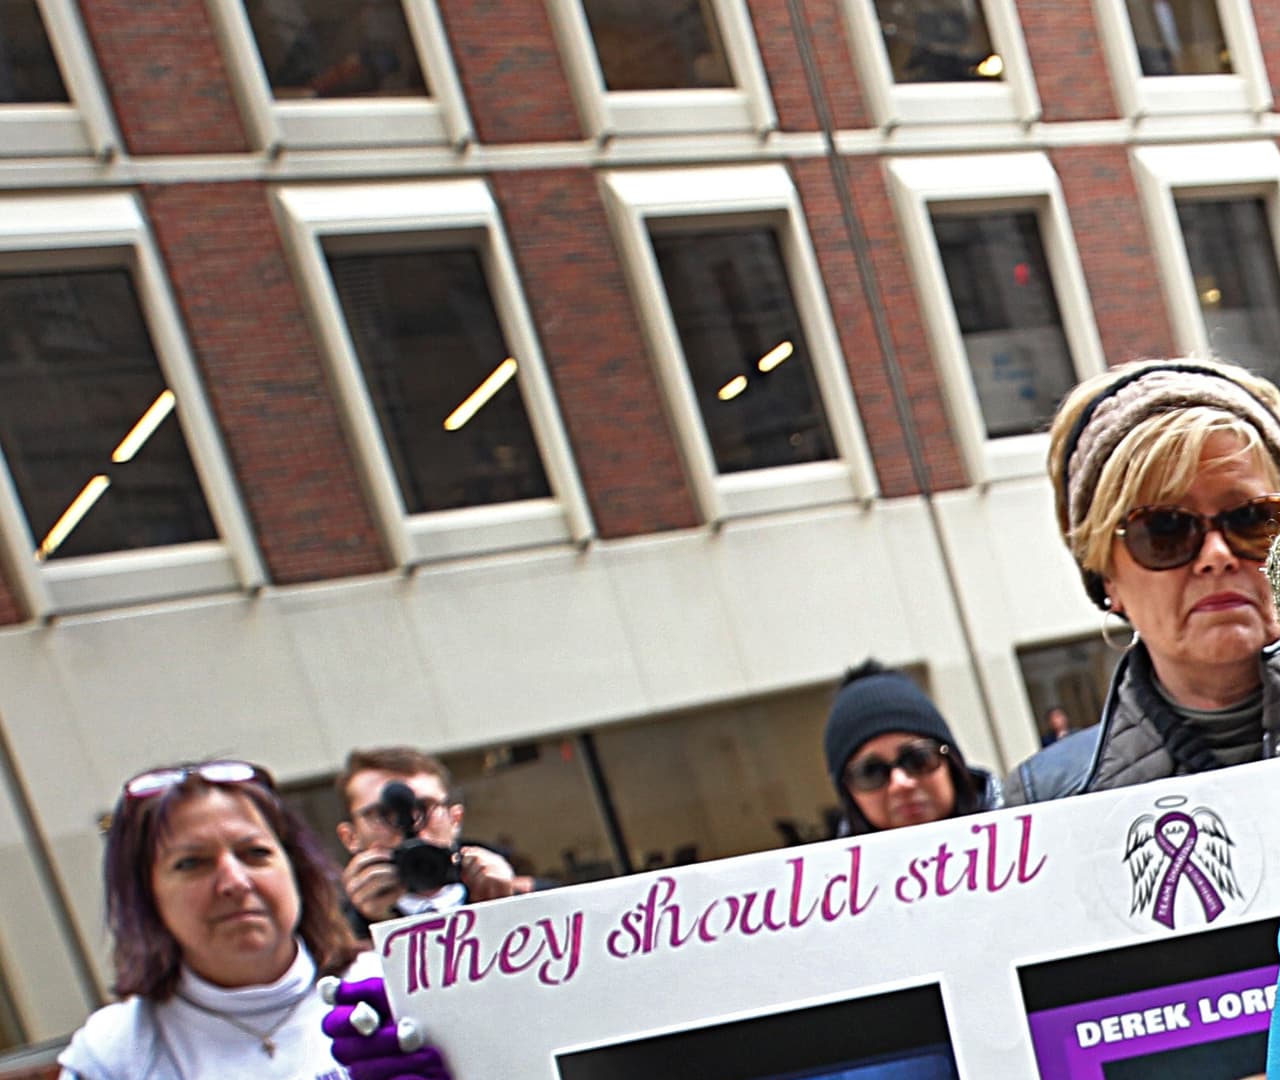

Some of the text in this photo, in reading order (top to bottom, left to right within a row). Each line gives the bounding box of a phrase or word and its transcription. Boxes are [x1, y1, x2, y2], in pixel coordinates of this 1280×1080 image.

[383, 909, 583, 994] They
[606, 845, 878, 959] should
[895, 814, 1048, 903] still
[1076, 1003, 1191, 1048] DEREK
